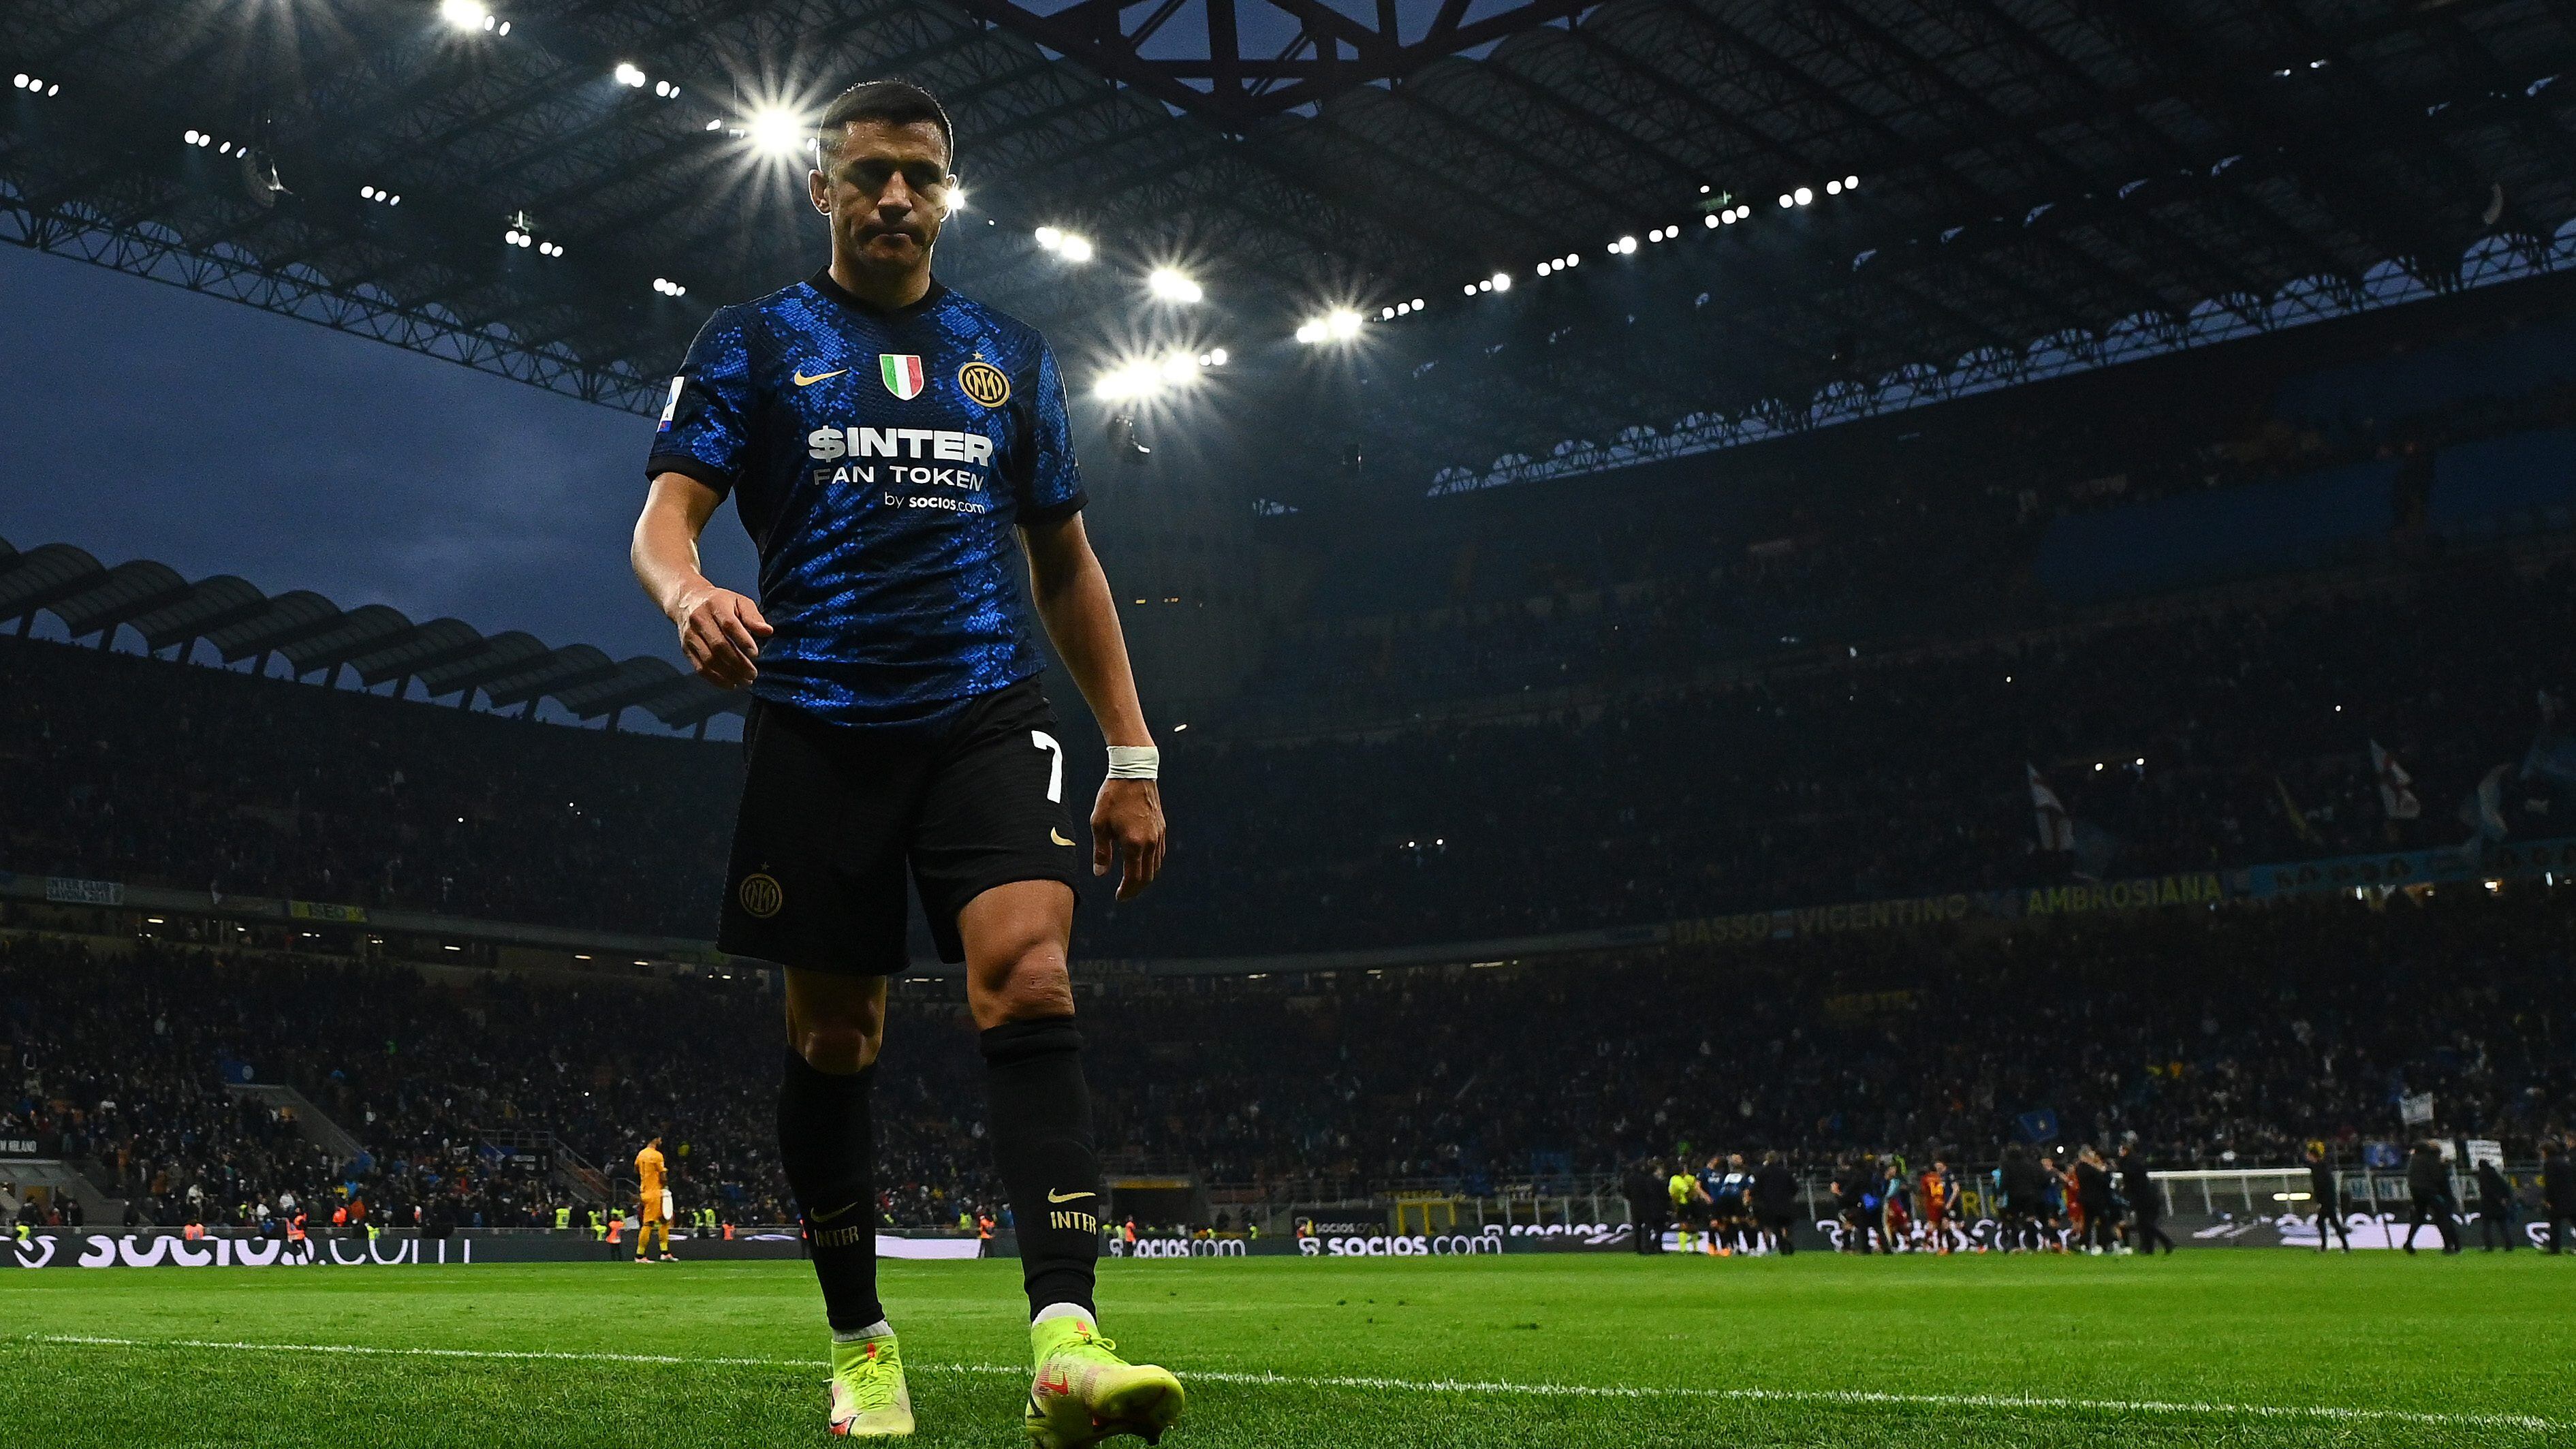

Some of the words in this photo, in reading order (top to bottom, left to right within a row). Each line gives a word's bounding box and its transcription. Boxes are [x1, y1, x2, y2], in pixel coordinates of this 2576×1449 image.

[808, 425, 994, 467] $INTER
[813, 466, 875, 486] FAN
[889, 465, 985, 492] TOKEN
[884, 491, 905, 509] by
[1031, 730, 1063, 804] 7
[2028, 873, 2223, 915] AMBROSIANA
[1795, 894, 1968, 934] VICENTINO
[814, 1226, 859, 1247] INTER
[1050, 1211, 1097, 1235] INTER
[1327, 1235, 1503, 1256] socioscom
